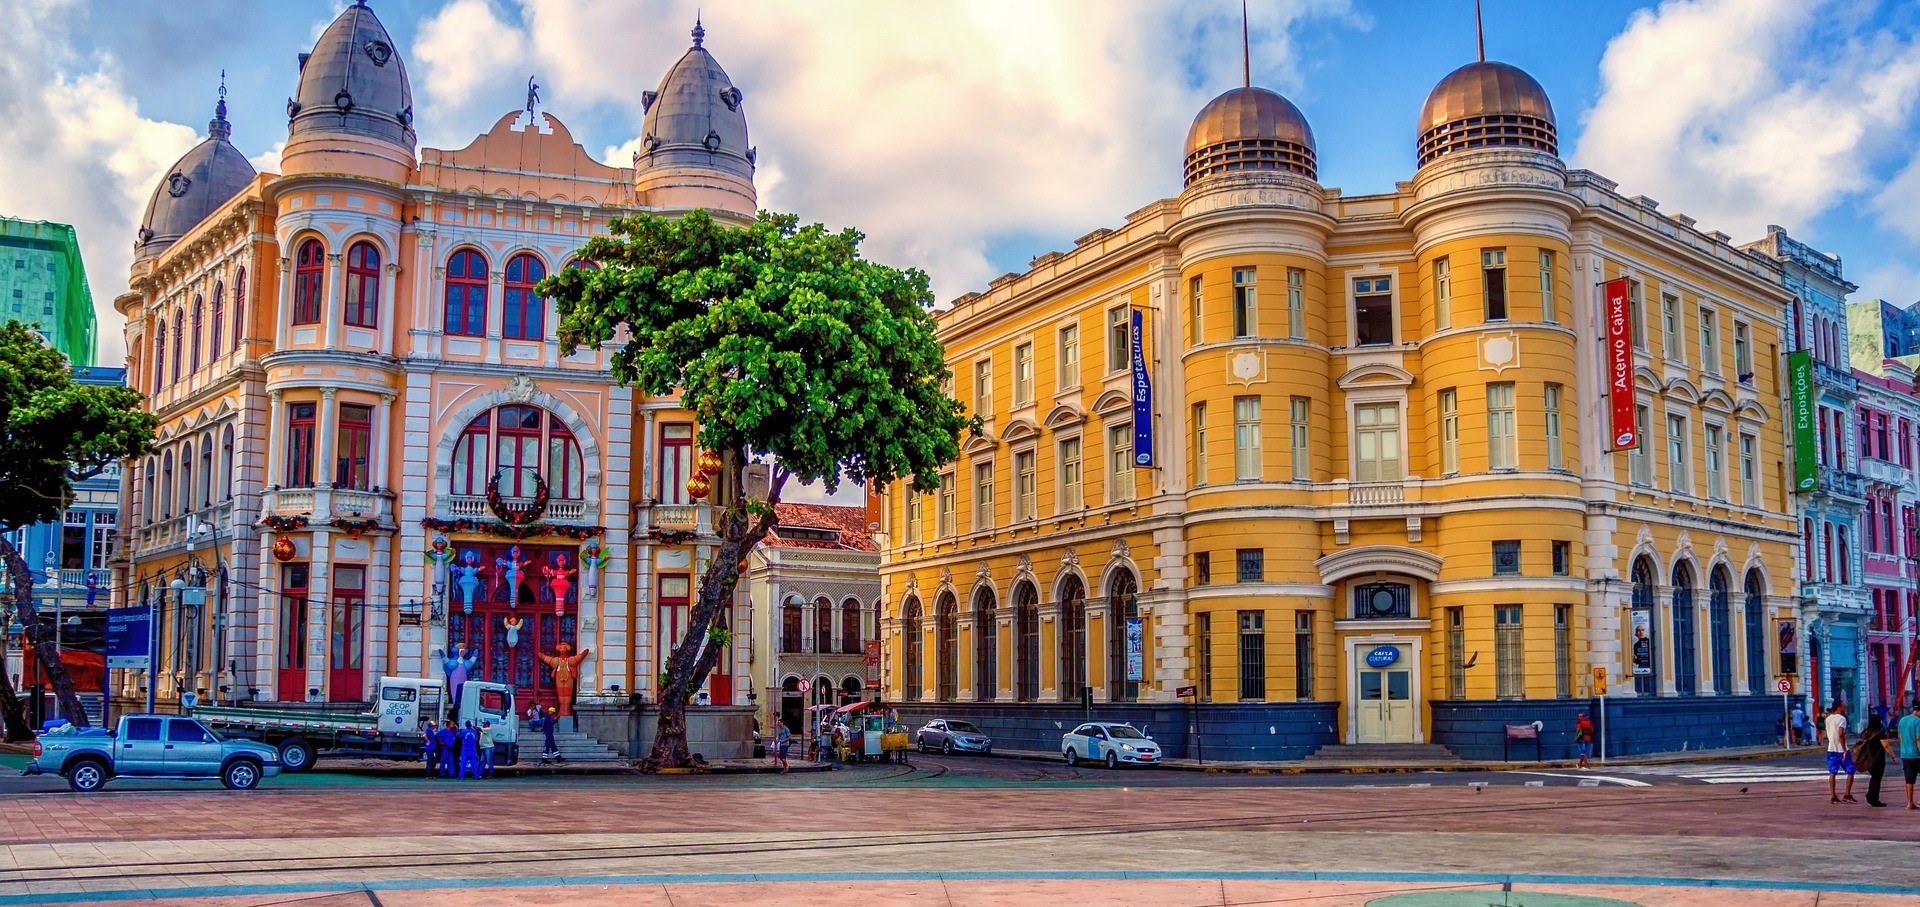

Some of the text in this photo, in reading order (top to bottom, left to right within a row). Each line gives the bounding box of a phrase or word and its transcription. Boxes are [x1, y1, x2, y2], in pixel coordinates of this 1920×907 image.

[1611, 295, 1627, 389] Acervo Caixa
[1797, 365, 1809, 429] Exposições
[385, 708, 412, 716] SECON
